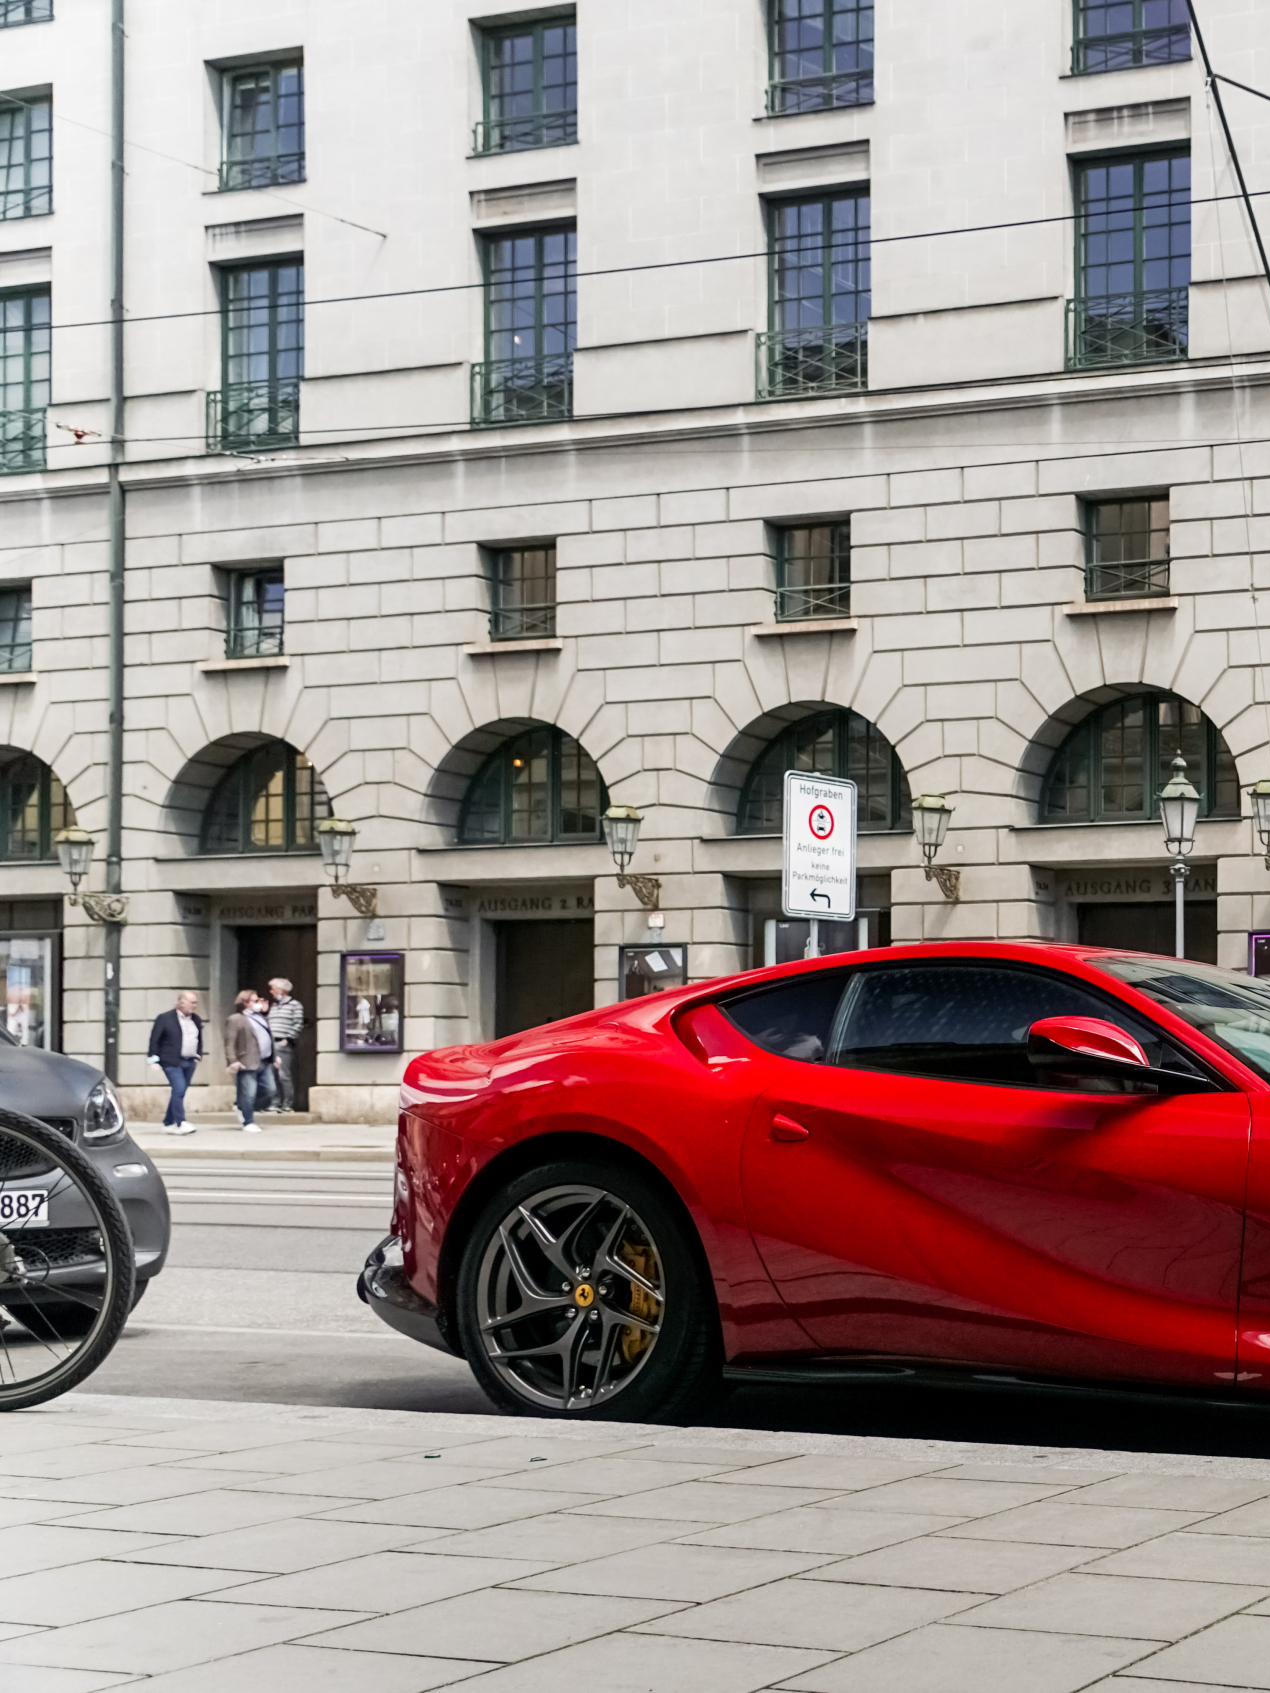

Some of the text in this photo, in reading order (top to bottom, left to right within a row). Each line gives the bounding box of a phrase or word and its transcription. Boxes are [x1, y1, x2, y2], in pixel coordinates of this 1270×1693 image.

[799, 784, 843, 800] Hofgraben
[797, 842, 844, 857] Anlieger frei
[811, 861, 830, 871] keine
[792, 871, 848, 885] Parkmöglichkeit
[1065, 879, 1151, 897] AUSGANG
[218, 905, 285, 920] AUSGANG
[478, 897, 552, 913] AUSGANG
[1, 1194, 44, 1218] 887
